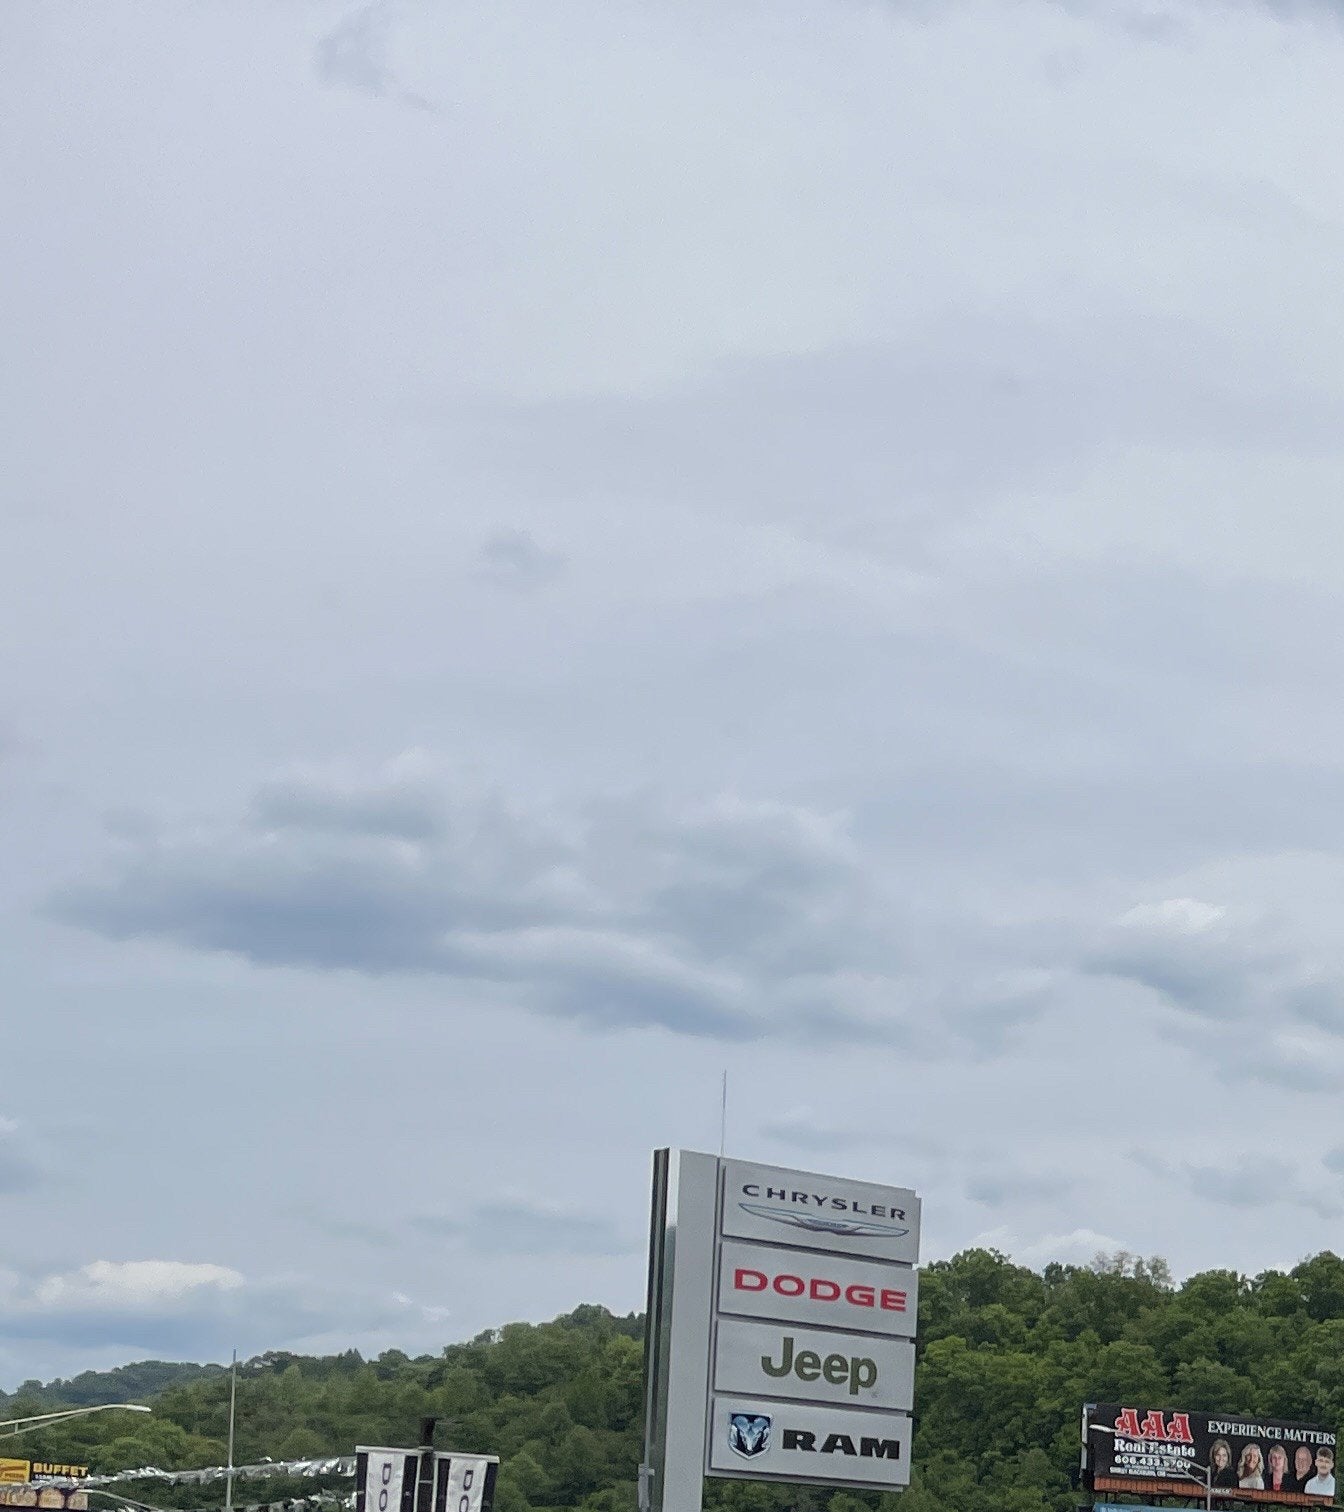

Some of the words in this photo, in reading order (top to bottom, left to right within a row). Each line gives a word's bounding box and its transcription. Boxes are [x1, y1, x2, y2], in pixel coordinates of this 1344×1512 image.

[742, 1184, 907, 1221] CHRYSLER
[734, 1268, 908, 1312] DODGE
[761, 1336, 878, 1395] Jeep
[1115, 1408, 1194, 1443] AAA
[1207, 1420, 1282, 1440] EXPERIENCE
[1284, 1428, 1336, 1446] MATTERS
[782, 1429, 901, 1460] RAM
[33, 1462, 88, 1477] BUFFET
